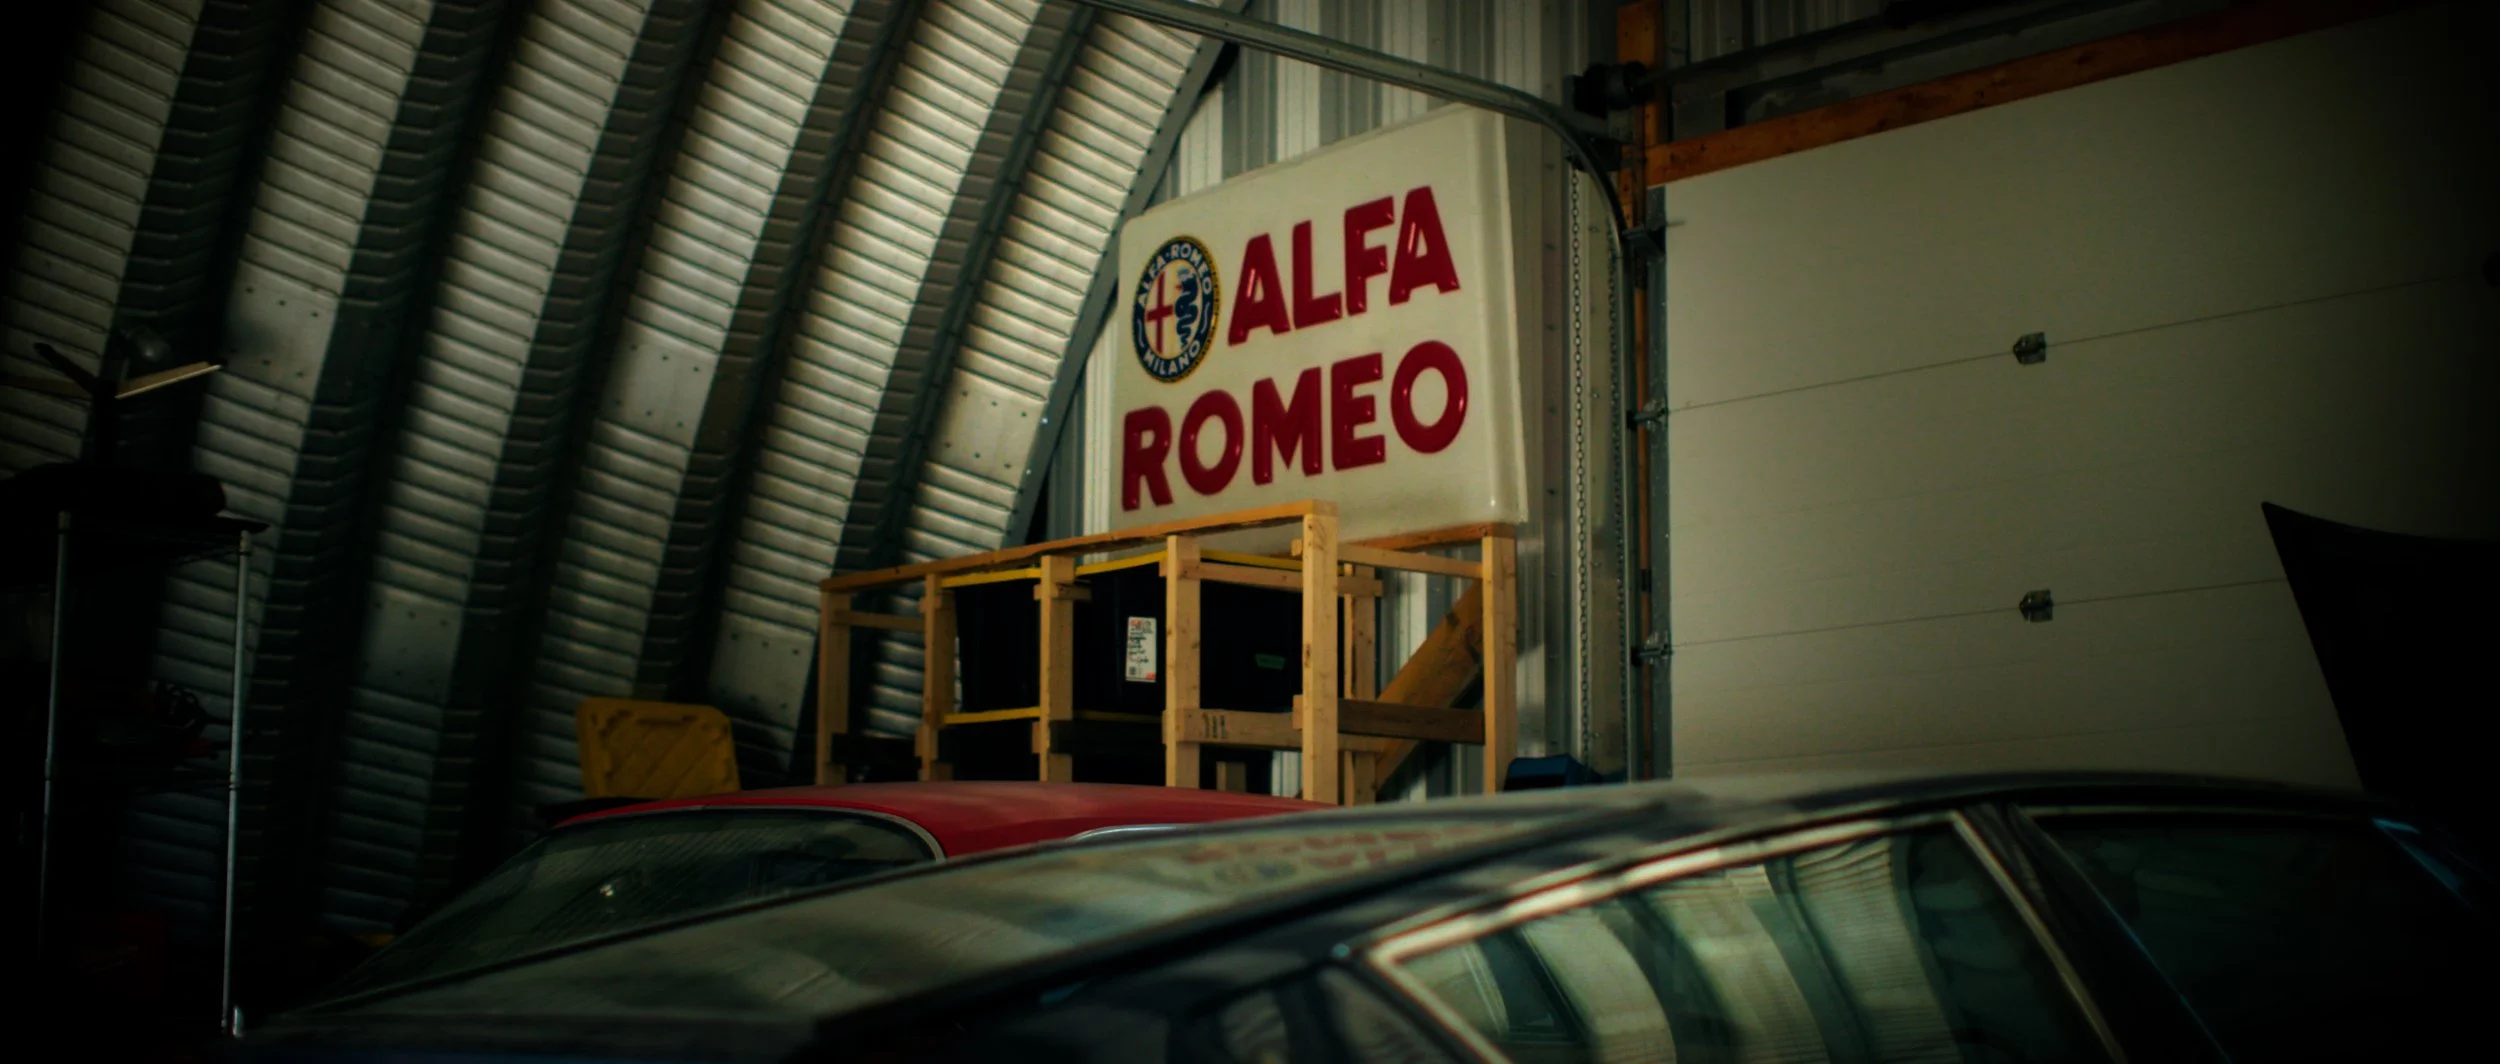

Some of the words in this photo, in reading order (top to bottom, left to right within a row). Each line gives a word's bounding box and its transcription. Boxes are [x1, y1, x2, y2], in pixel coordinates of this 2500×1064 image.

[1227, 185, 1461, 347] ALFA
[1121, 340, 1469, 512] ROMEO
[1143, 340, 1201, 376] MILANO
